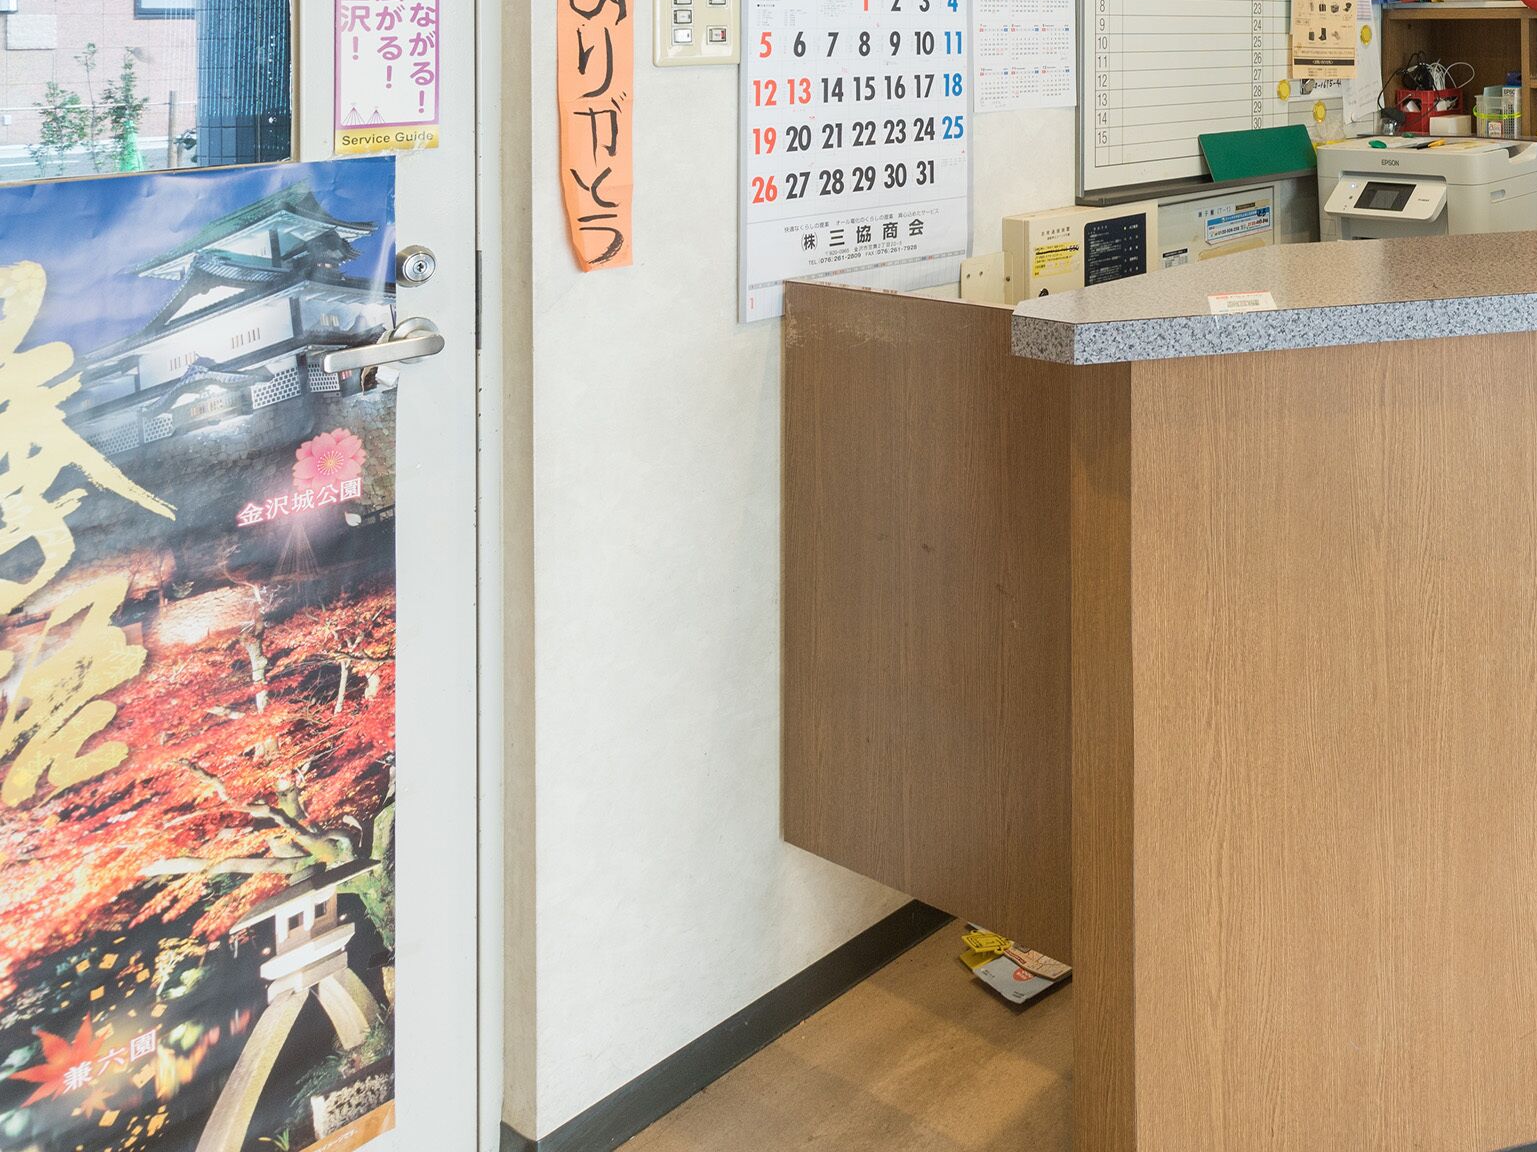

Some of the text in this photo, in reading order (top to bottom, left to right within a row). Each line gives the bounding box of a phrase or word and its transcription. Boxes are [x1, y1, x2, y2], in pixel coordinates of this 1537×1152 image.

[1099, 0, 1106, 12] 8
[1253, 3, 1262, 14] 23
[1099, 18, 1106, 31] 9
[1253, 19, 1262, 32] 24
[760, 31, 961, 58] 5 6 7 8 9 10 11
[1098, 36, 1107, 49] 10
[1253, 36, 1262, 47] 25
[1098, 56, 1107, 68] 11
[1253, 52, 1262, 64] 26
[1098, 74, 1107, 87] 12
[1253, 68, 1262, 81] 27
[753, 73, 962, 106] 12 13 14 15 16 17 18
[1253, 85, 1262, 97] 28
[1503, 88, 1516, 97] EPSO
[1098, 93, 1107, 106] 13
[1253, 101, 1262, 113] 29
[1098, 112, 1107, 124] 14
[1253, 117, 1262, 130] 30
[342, 131, 434, 147] Service Guide
[753, 116, 963, 154] 19 20 21 22 23 24 25
[1098, 131, 1107, 144] 15
[1381, 158, 1400, 167] EPSON
[752, 160, 934, 203] 26 27 28 29 30 31
[829, 219, 924, 247] 三協商会
[237, 477, 362, 527] 金沢城公園
[63, 1030, 156, 1091] 兼六園
